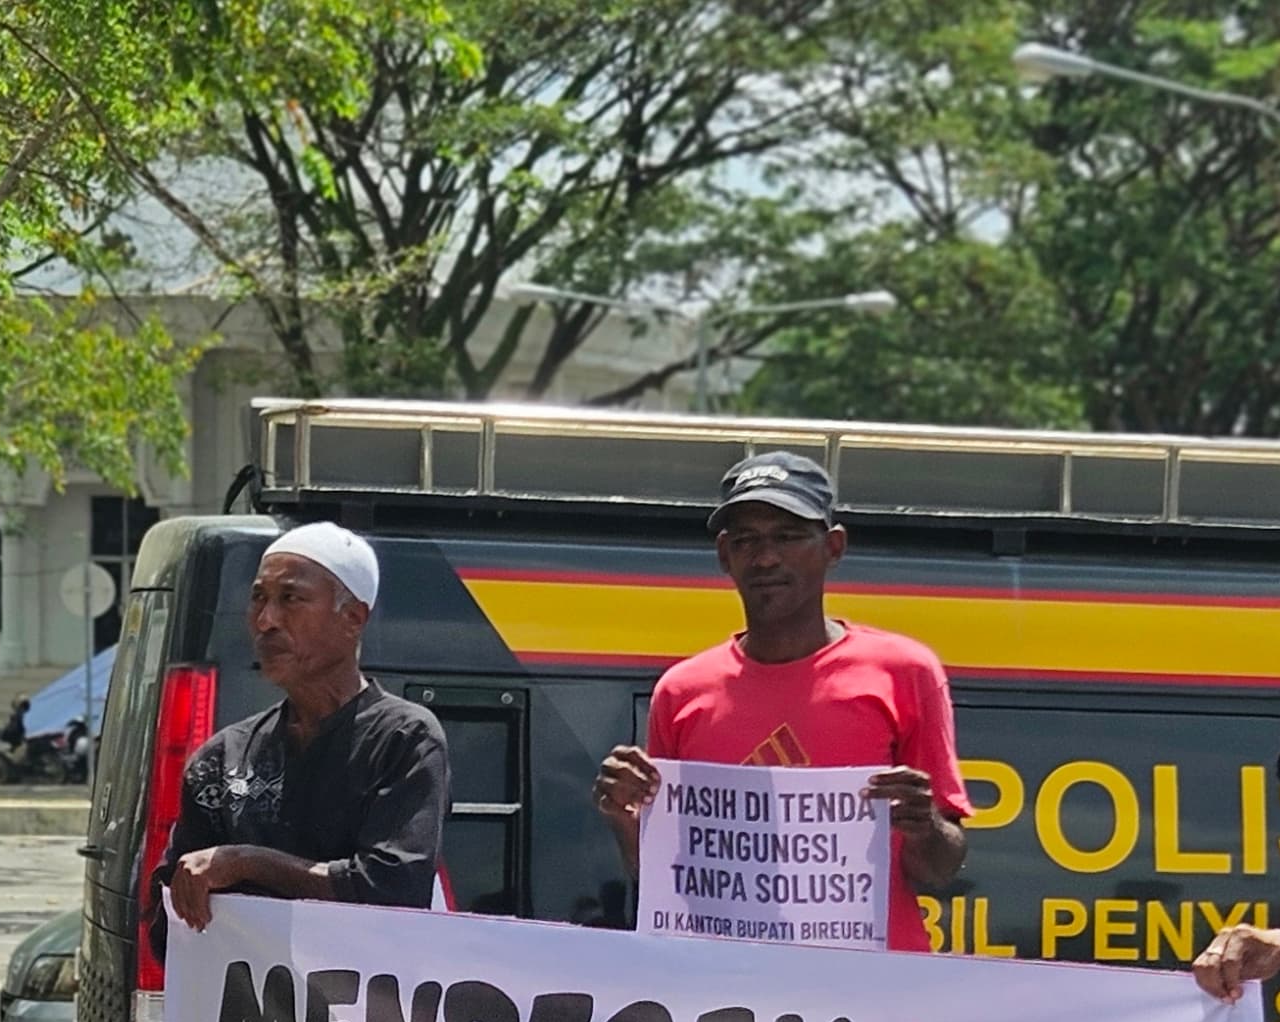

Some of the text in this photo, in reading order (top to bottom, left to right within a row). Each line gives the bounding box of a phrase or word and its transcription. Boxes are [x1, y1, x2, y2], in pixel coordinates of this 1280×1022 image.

[667, 784, 876, 823] MASIH DI TENDA
[689, 826, 847, 866] PENGUNGSI,
[671, 864, 873, 903] TANPA SOLUSI?
[653, 911, 669, 930] DI
[674, 912, 733, 936] KANTOR
[737, 920, 794, 941] BUPATI
